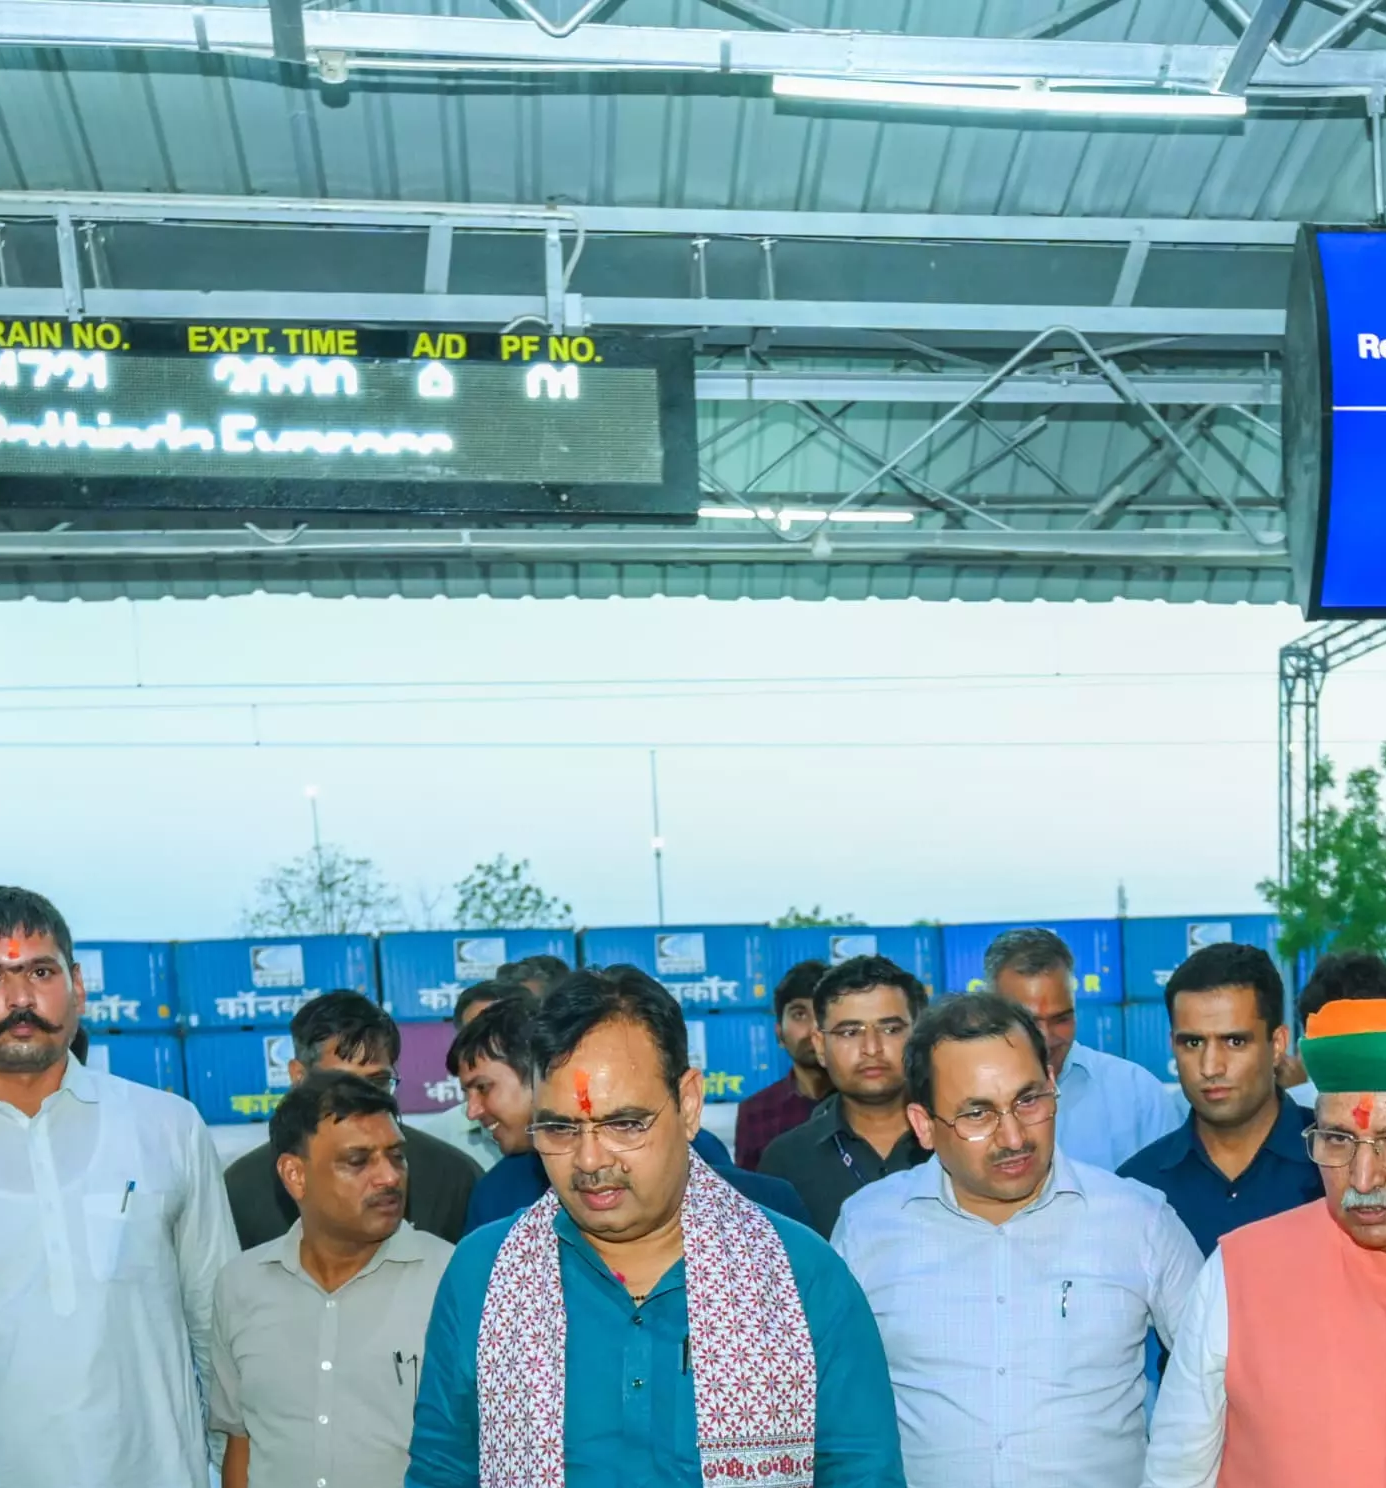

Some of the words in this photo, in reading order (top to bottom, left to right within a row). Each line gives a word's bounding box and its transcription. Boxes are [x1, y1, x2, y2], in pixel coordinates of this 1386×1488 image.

[72, 322, 130, 350] NO.
[187, 326, 275, 352] EXPT.
[282, 328, 358, 355] TIME
[412, 332, 467, 359] A/D
[500, 335, 541, 361] PF
[548, 336, 604, 363] NO.
